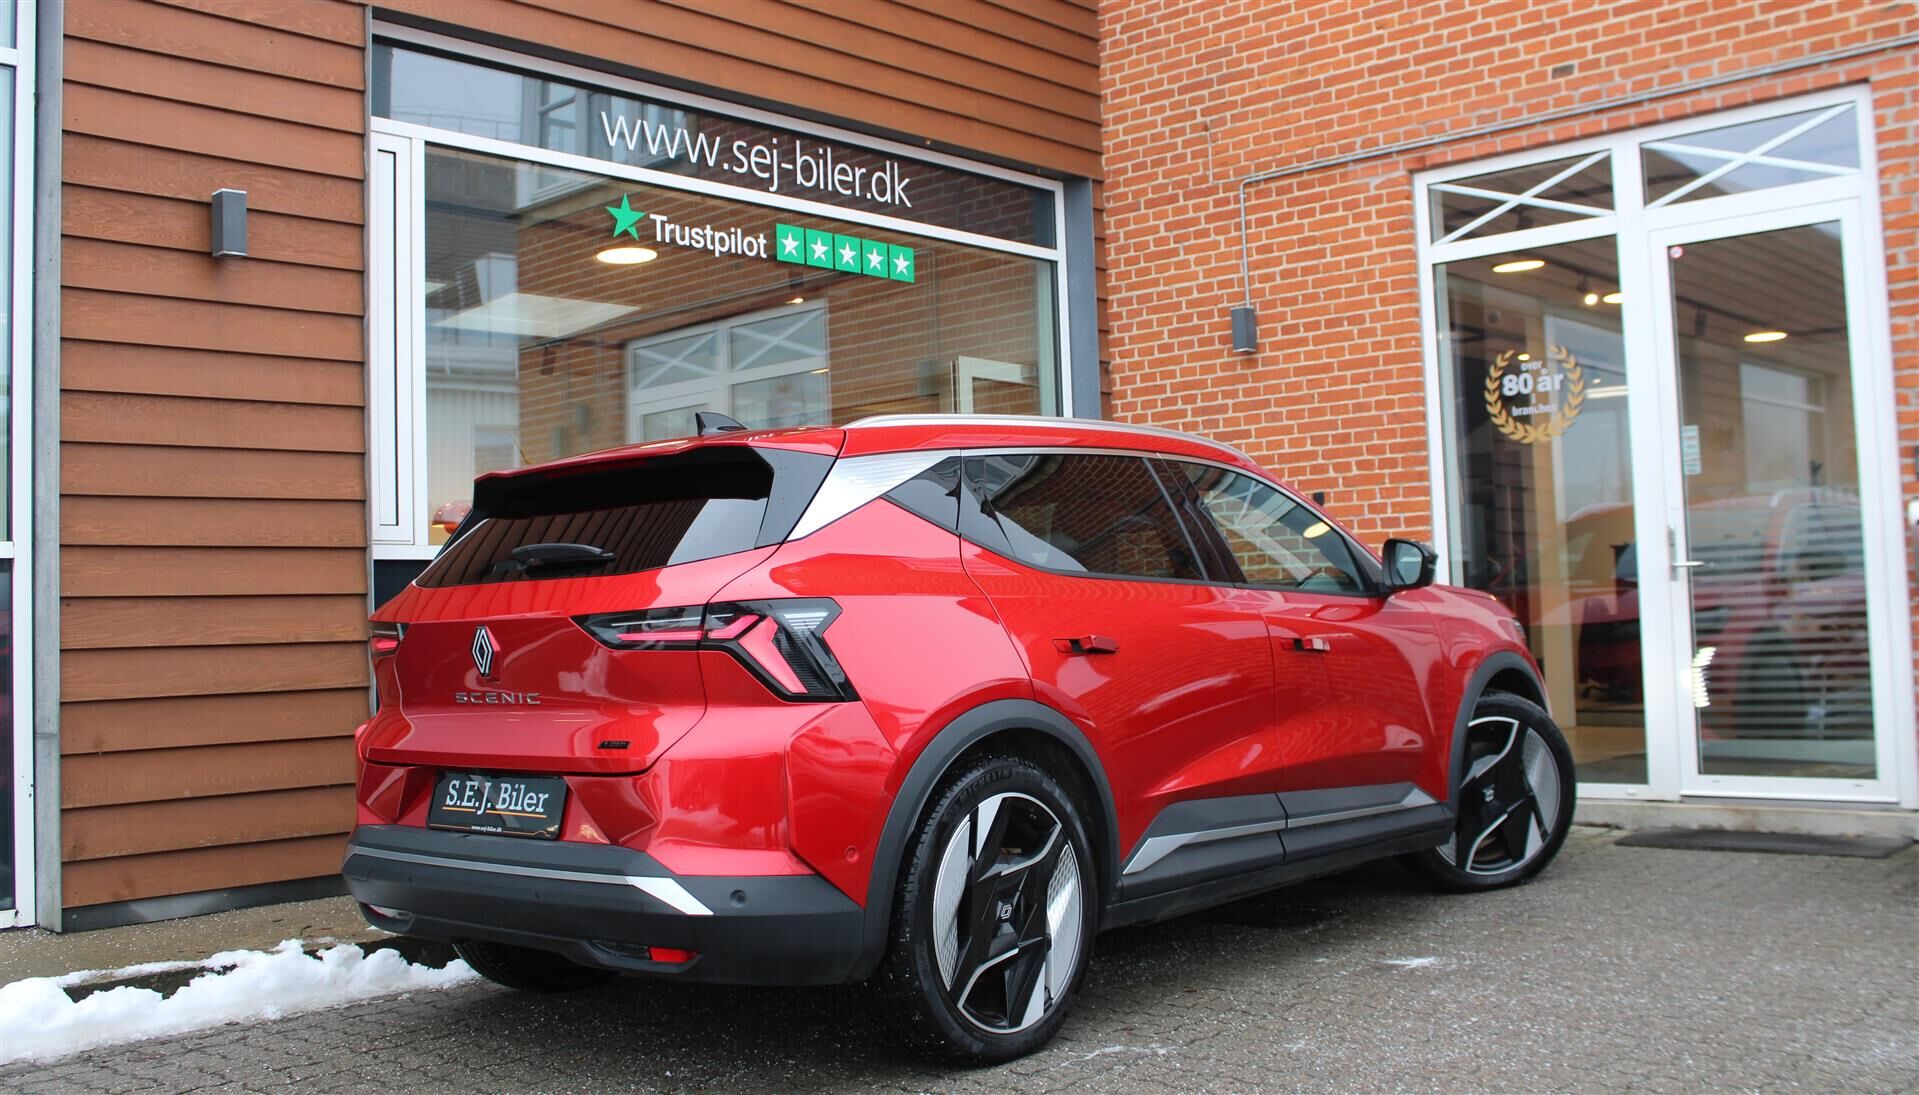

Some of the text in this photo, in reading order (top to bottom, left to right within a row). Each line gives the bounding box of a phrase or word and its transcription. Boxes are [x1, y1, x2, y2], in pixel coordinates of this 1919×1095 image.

[601, 111, 912, 208] www.sej-biler.dk
[649, 213, 768, 259] Trustpilot
[1502, 368, 1564, 396] 80 år
[1520, 361, 1543, 371] over
[455, 692, 541, 705] SCENIC
[445, 779, 549, 815] S.E.J. Biler
